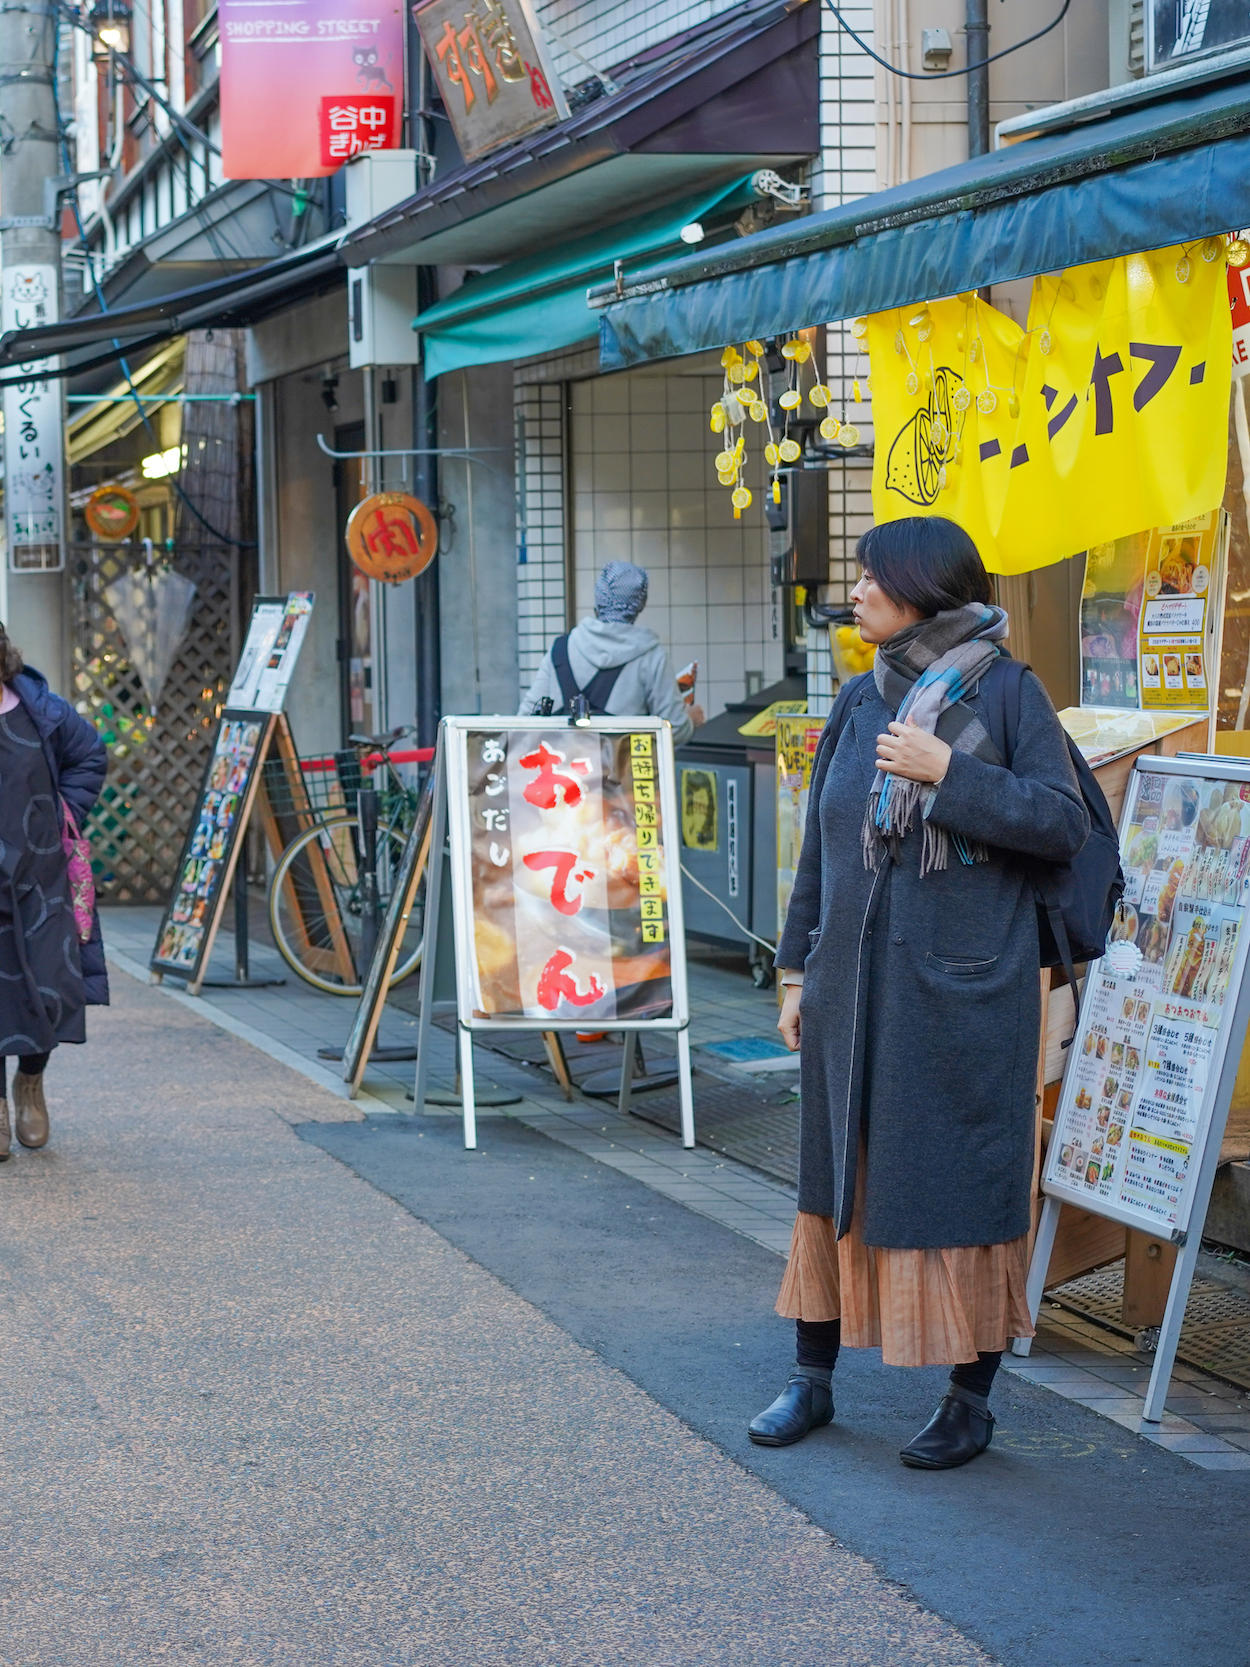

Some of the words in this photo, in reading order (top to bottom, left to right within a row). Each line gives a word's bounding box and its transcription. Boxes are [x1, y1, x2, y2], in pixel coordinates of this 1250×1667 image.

[225, 20, 310, 36] SHOPPING
[317, 19, 381, 34] STREET
[328, 106, 386, 131] 谷中
[481, 739, 510, 867] あごだし
[632, 736, 663, 940] お持ち帰りできます
[518, 740, 608, 1012] おでん
[1163, 1001, 1210, 1025] あつあつおでん
